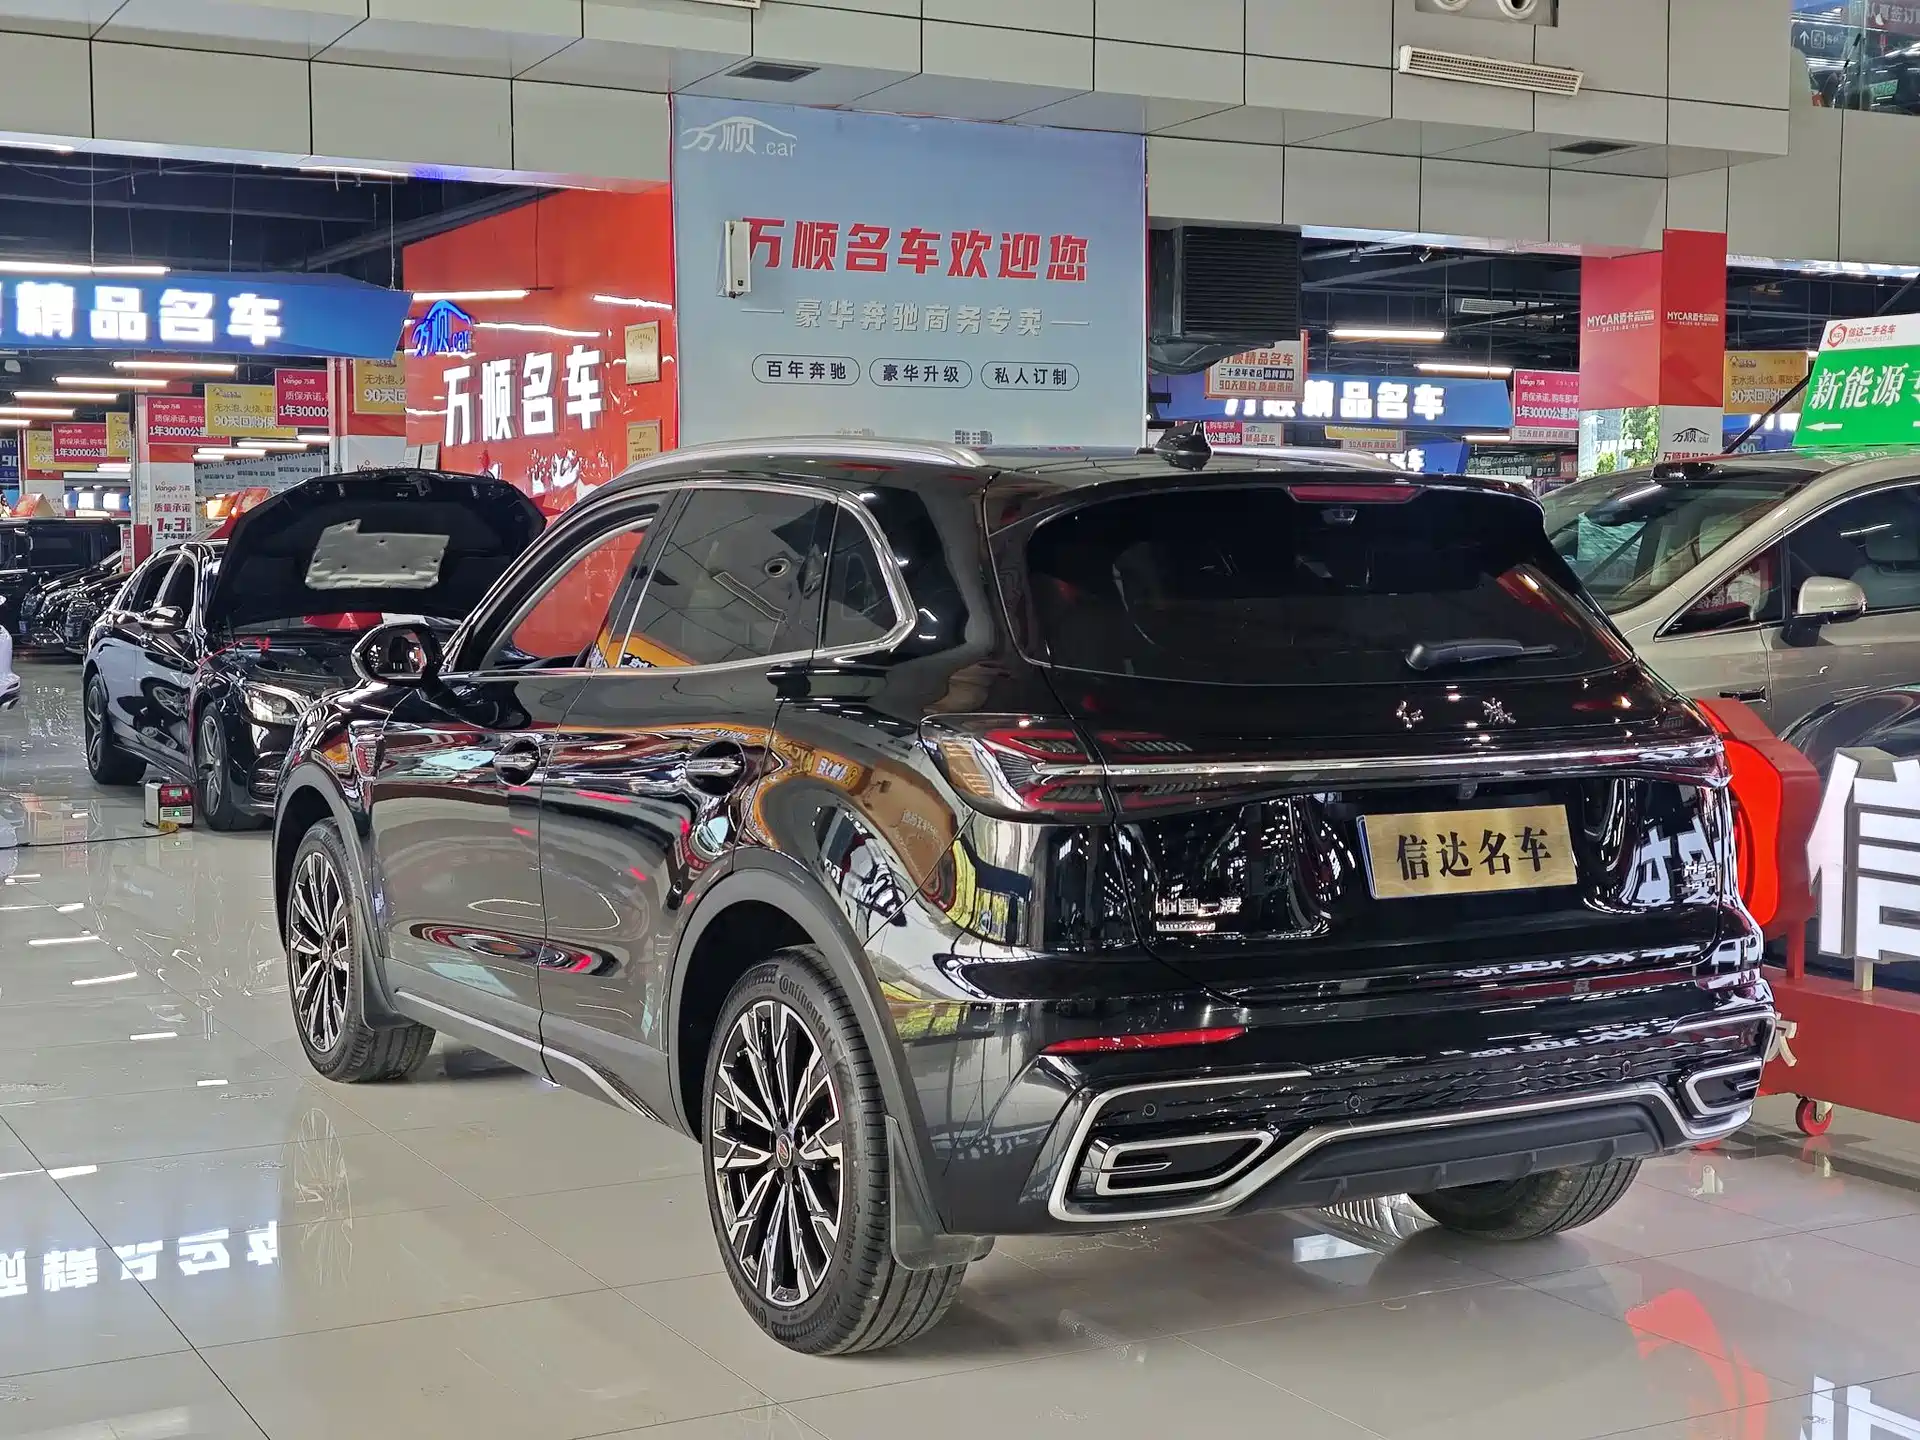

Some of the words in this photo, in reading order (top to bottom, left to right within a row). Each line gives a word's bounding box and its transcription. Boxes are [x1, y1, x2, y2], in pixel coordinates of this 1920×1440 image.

[742, 216, 1089, 282] 万顺名车欢迎您
[15, 281, 284, 346] 精品名车
[794, 299, 1045, 337] 豪华奔驰商务专卖
[442, 343, 606, 447] 万顺名车
[766, 359, 848, 381] 百年奔驰
[882, 363, 960, 385] 豪华升级
[994, 366, 1068, 386] 私人订制
[279, 404, 329, 417] 1年30000
[1397, 826, 1551, 881] 信达名车
[780, 974, 831, 1041] Continental
